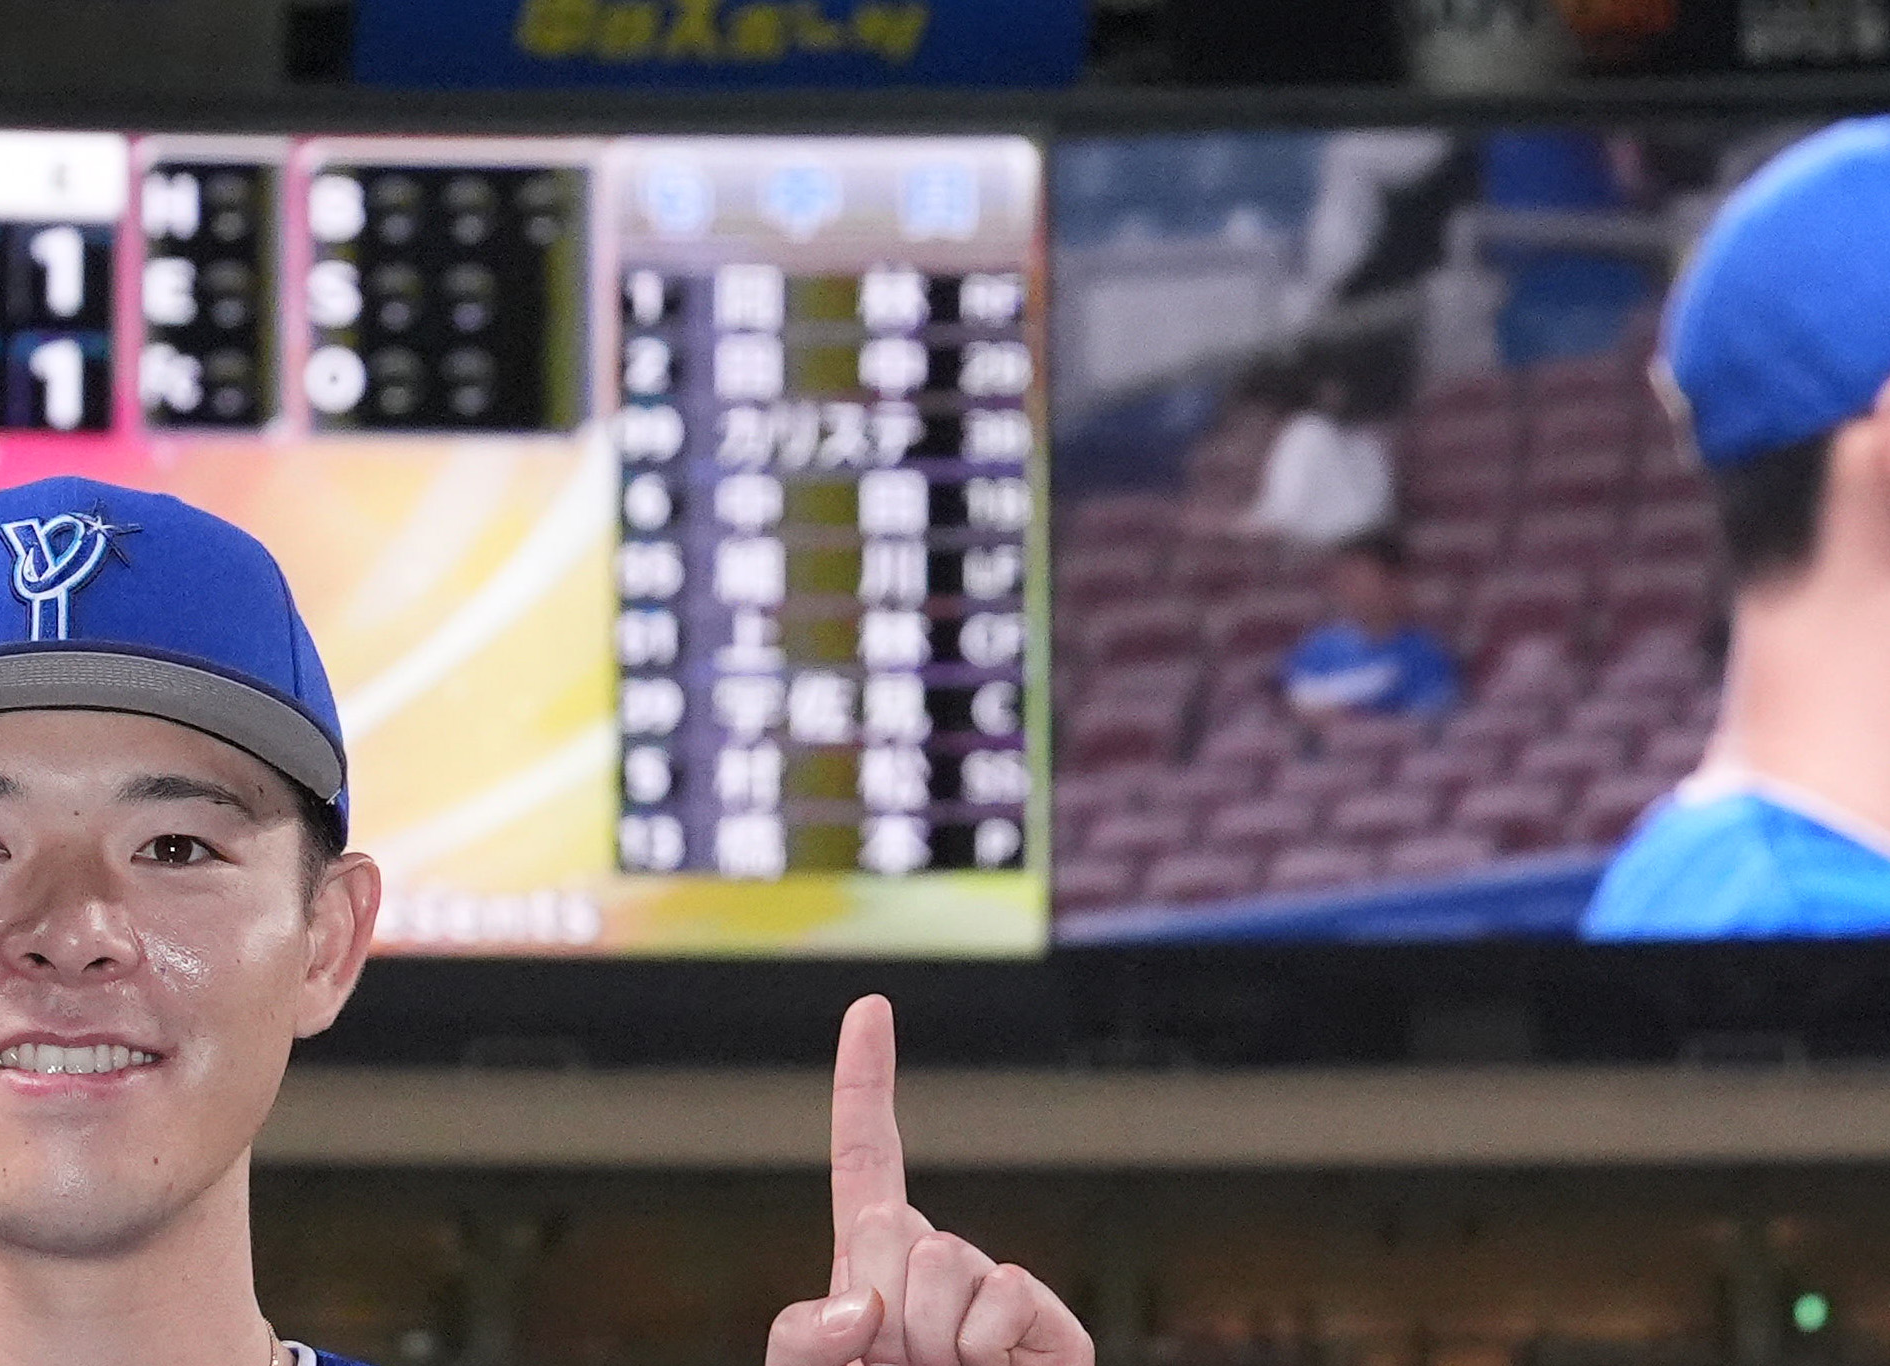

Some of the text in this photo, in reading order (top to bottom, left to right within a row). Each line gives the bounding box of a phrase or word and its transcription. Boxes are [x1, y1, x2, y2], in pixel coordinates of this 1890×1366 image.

[141, 171, 201, 240] H
[28, 223, 87, 320] 1
[141, 257, 198, 325] E
[306, 259, 363, 327] S
[28, 337, 86, 433] 1
